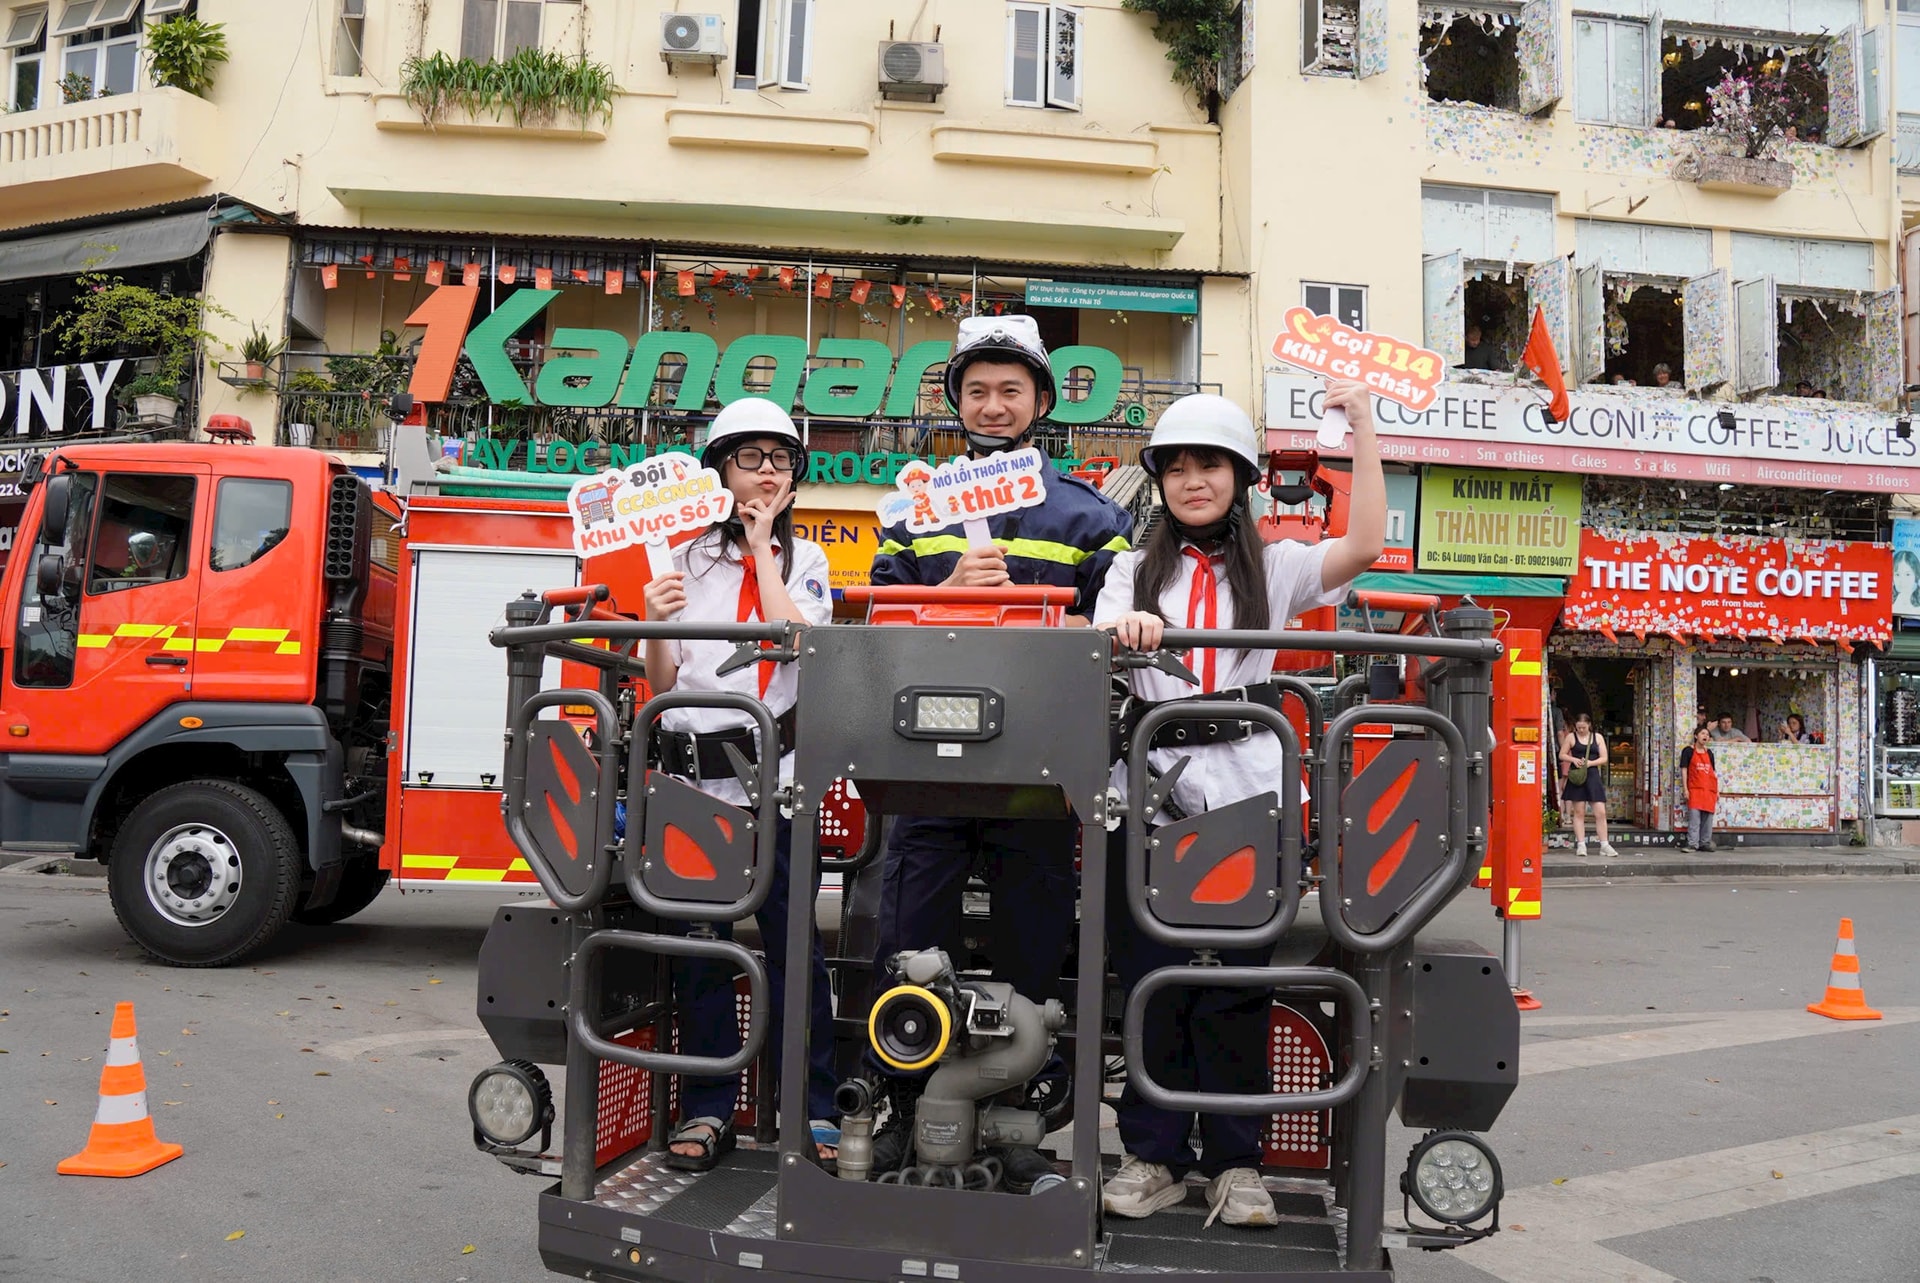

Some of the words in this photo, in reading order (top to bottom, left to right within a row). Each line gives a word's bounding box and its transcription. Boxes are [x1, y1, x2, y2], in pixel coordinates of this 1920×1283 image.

[1072, 287, 1088, 295] Công
[1088, 288, 1096, 296] ty
[1118, 289, 1139, 297] doanh
[1140, 290, 1169, 299] Kangaroo
[1170, 291, 1186, 300] Quốc
[404, 285, 1122, 424] Kangaro
[1281, 339, 1328, 366] Khi
[1330, 358, 1361, 378] có
[1364, 371, 1428, 404] cháy
[1331, 331, 1373, 356] Gọi
[1373, 342, 1434, 380] 114
[0, 359, 125, 434] NY
[1687, 415, 1800, 450] COFFEE
[1822, 423, 1917, 457] JUICES
[630, 462, 667, 488] Đội
[954, 463, 972, 485] LỐI
[973, 458, 1008, 481] THOÁT
[1011, 455, 1035, 472] NẠN
[1291, 434, 1347, 451] Espro
[1572, 453, 1608, 469] Cakes
[1634, 458, 1678, 473] Snacks
[1705, 462, 1732, 476] Wifi
[1756, 465, 1843, 484] Airconditioner
[1866, 473, 1874, 486] 3
[1875, 474, 1911, 488] floors
[617, 475, 714, 515] CC&CNCH
[961, 476, 1015, 513] thứ
[1018, 476, 1039, 500] 2
[1453, 475, 1502, 500] KÍNH
[1510, 476, 1553, 502] MẮT
[580, 525, 626, 551] Khu
[629, 512, 677, 538] Vực
[680, 495, 710, 523] Số
[712, 496, 727, 514] 7
[793, 519, 858, 546] ĐIỆN
[1435, 505, 1512, 546] THÀNH
[1427, 551, 1440, 562] ĐC:
[1442, 552, 1451, 562] 64
[1453, 552, 1476, 564] Lương
[1478, 553, 1492, 564] Văn
[1493, 554, 1508, 564] Can
[1585, 559, 1651, 590] THE
[1660, 563, 1748, 595] NOTE
[1755, 567, 1879, 600] COFFEE
[1701, 599, 1720, 607] post
[1722, 599, 1741, 607] from
[1743, 600, 1767, 608] heart.
